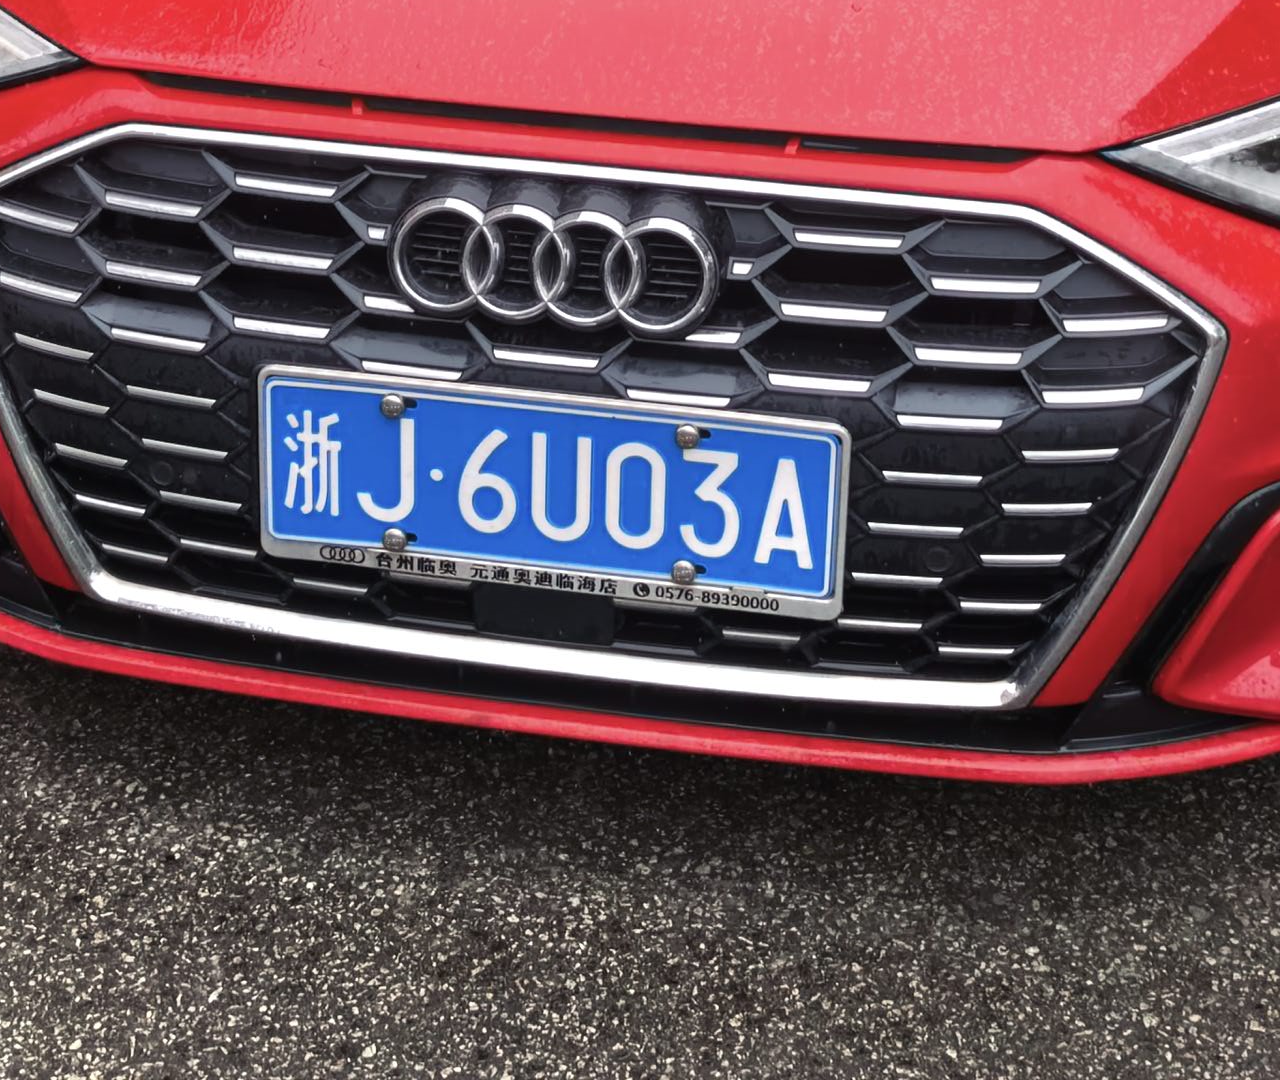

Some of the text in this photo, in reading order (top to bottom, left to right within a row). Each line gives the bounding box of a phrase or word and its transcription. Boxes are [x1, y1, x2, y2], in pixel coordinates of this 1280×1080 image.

[375, 552, 457, 576] 台州临奥
[655, 586, 780, 612] 0576-89390000
